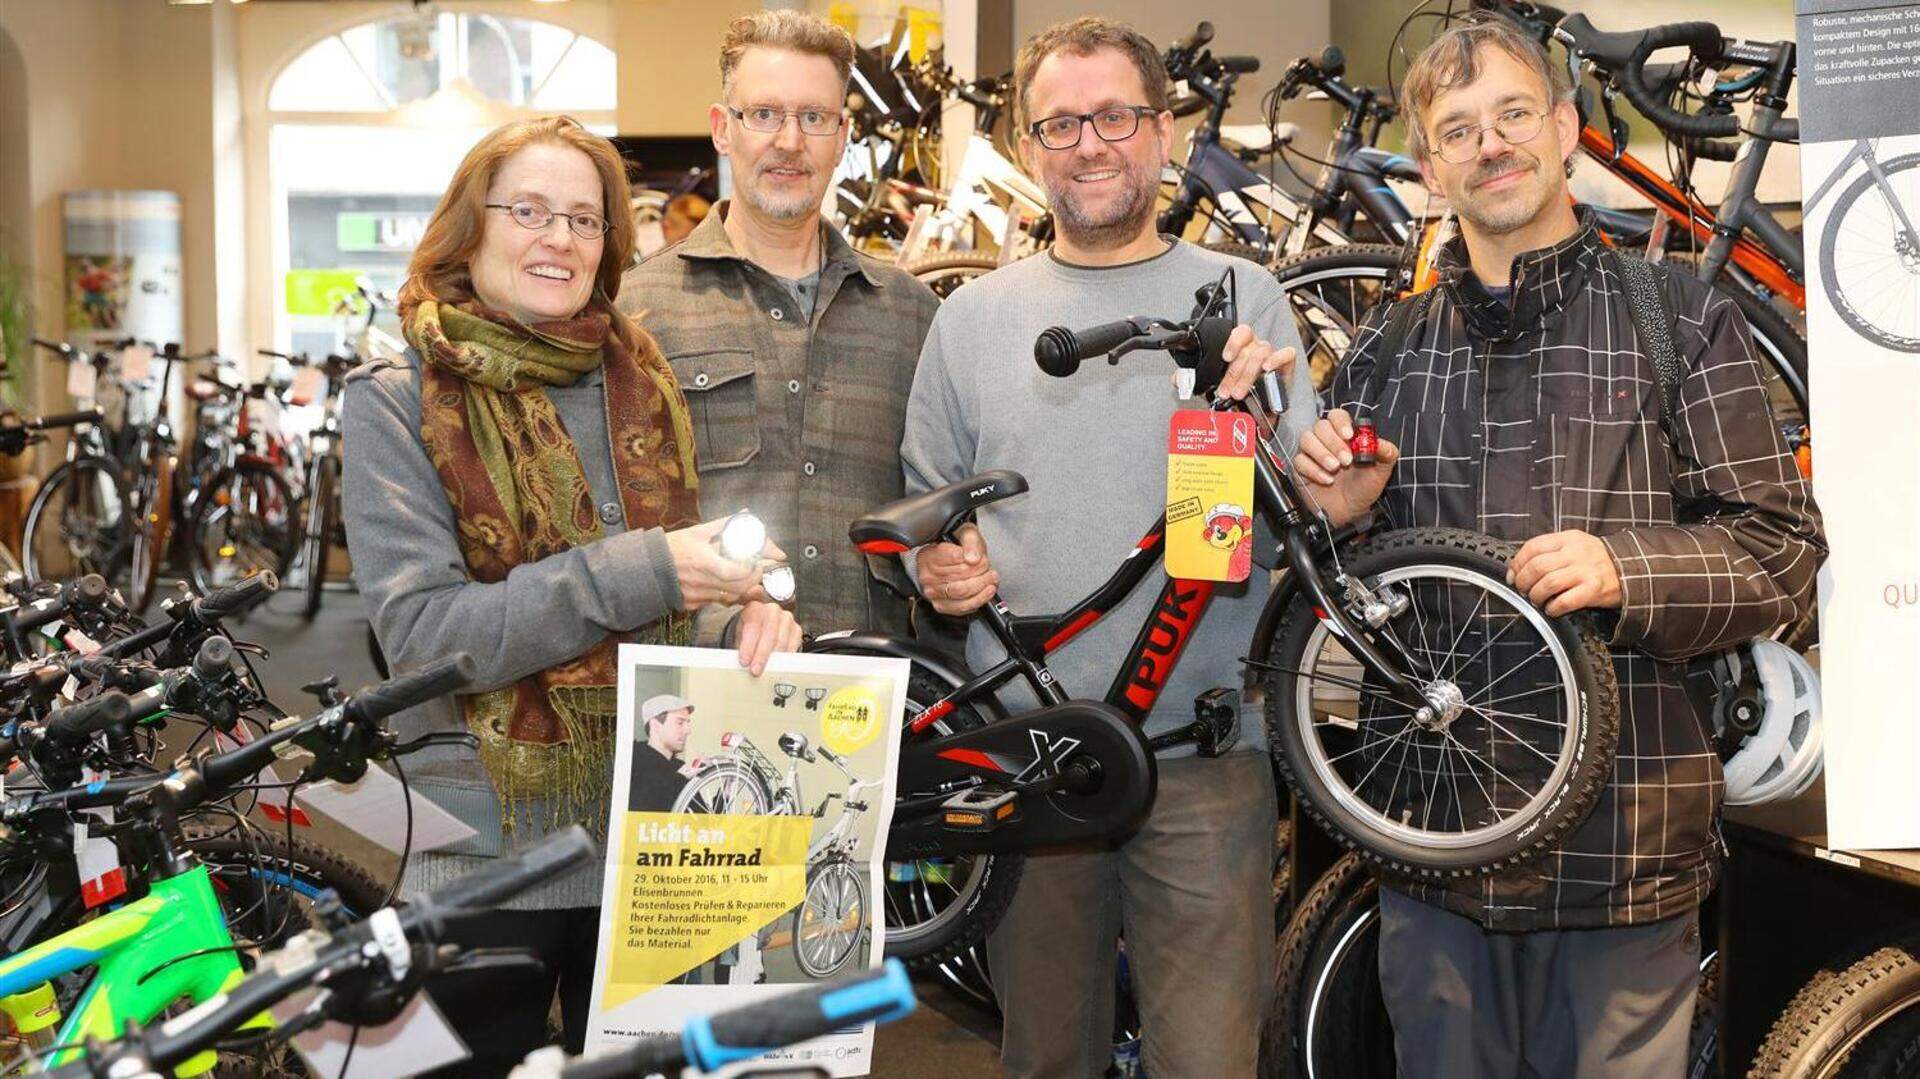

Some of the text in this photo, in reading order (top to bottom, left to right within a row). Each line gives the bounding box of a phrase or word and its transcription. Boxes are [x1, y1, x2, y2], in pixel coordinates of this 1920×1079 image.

[1812, 17, 1848, 27] Robuste,
[1850, 11, 1903, 23] mechanische
[1813, 30, 1861, 42] kompaktem
[1863, 28, 1892, 38] Design
[1893, 26, 1907, 35] mit
[1813, 47, 1837, 57] vorne
[1839, 44, 1855, 54] und
[1887, 41, 1901, 50] Die
[1814, 62, 1828, 72] das
[1831, 58, 1869, 70] kraftvolle
[1871, 55, 1911, 67] Zupacken
[1814, 76, 1851, 87] Situation
[1853, 74, 1866, 83] ein
[1868, 71, 1901, 82] sicheres
[970, 484, 995, 498] PUKY
[1168, 504, 1186, 513] MADE
[1168, 507, 1199, 521] GERMANY
[1131, 579, 1199, 690] PUK
[1516, 783, 1570, 842] BLACK JACK
[638, 822, 725, 844] Licht an
[636, 848, 762, 867] am Fahrrad
[652, 874, 692, 884] Oktober
[694, 874, 719, 886] 2016,
[722, 874, 730, 883] 11
[740, 873, 750, 883] 15
[752, 874, 768, 883] Uhr
[632, 887, 703, 897] Elisenbrunnen
[631, 900, 786, 912] Kostenloses Prüfen & Reparieren
[630, 913, 749, 925] Ihrer Fahrradlichtanlage.
[628, 926, 711, 936] Sie bezahlen nur
[627, 938, 693, 949] das Material.
